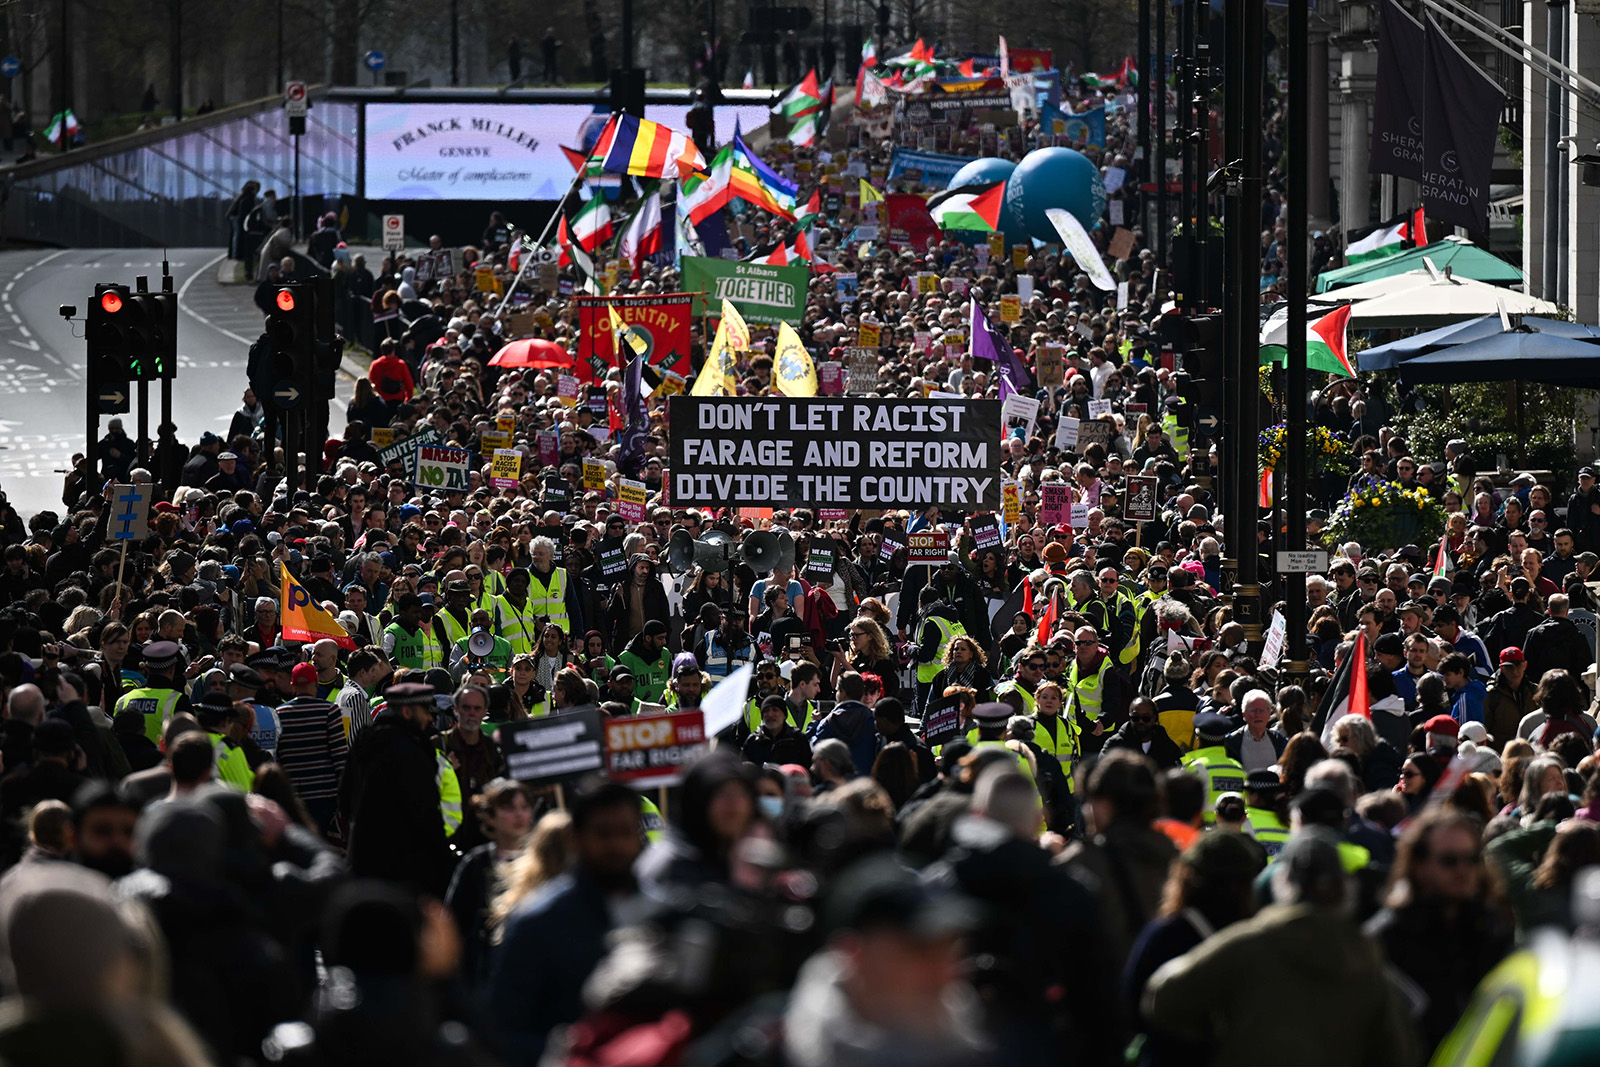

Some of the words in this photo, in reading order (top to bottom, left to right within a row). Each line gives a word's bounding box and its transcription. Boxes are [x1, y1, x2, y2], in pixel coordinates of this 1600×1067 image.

[393, 117, 462, 151] FRANCK
[472, 117, 540, 153] MULLER
[398, 166, 446, 182] Master
[448, 167, 464, 185] of
[1423, 185, 1469, 206] GRAND
[736, 265, 747, 274] St
[750, 267, 778, 277] Albans
[717, 278, 795, 305] TOGETHER
[625, 298, 661, 306] EDUCATION
[667, 297, 691, 305] UNION
[589, 307, 680, 338] COENTRY
[699, 402, 781, 430] DON'T
[790, 404, 844, 430] LET
[853, 405, 966, 432] RACIST
[1084, 423, 1108, 434] FUCK
[422, 447, 469, 464] NAZIS?
[684, 439, 793, 466] FARAGE
[803, 441, 860, 467] AND
[869, 441, 988, 469] REFORM
[420, 465, 444, 486] NO
[621, 485, 645, 497] Refugees
[676, 473, 788, 500] DIVIDE
[797, 475, 851, 502] THE
[860, 476, 993, 504] COUNTRY
[1044, 487, 1066, 496] SMASH
[621, 492, 643, 503] welcome
[1044, 495, 1056, 503] THE
[1057, 495, 1069, 504] FAR
[620, 501, 632, 510] Stop
[633, 503, 642, 511] the
[1044, 503, 1063, 512] RIGHT
[629, 509, 641, 519] right
[885, 537, 892, 545] WE
[909, 536, 935, 547] STOP
[601, 551, 611, 559] WE
[611, 548, 622, 556] ARE
[925, 548, 946, 557] RIGHT
[1297, 552, 1317, 560] loading
[614, 564, 627, 572] RIGHT
[400, 645, 416, 659] FOA
[128, 699, 157, 714] POLICE
[929, 712, 937, 720] WE
[940, 705, 955, 717] ARE
[926, 723, 947, 733] AGAINST
[926, 730, 938, 739] FAR
[939, 722, 957, 734] RIGHT
[608, 720, 674, 749] STOP
[676, 725, 701, 740] THE
[610, 752, 646, 772] FAR
